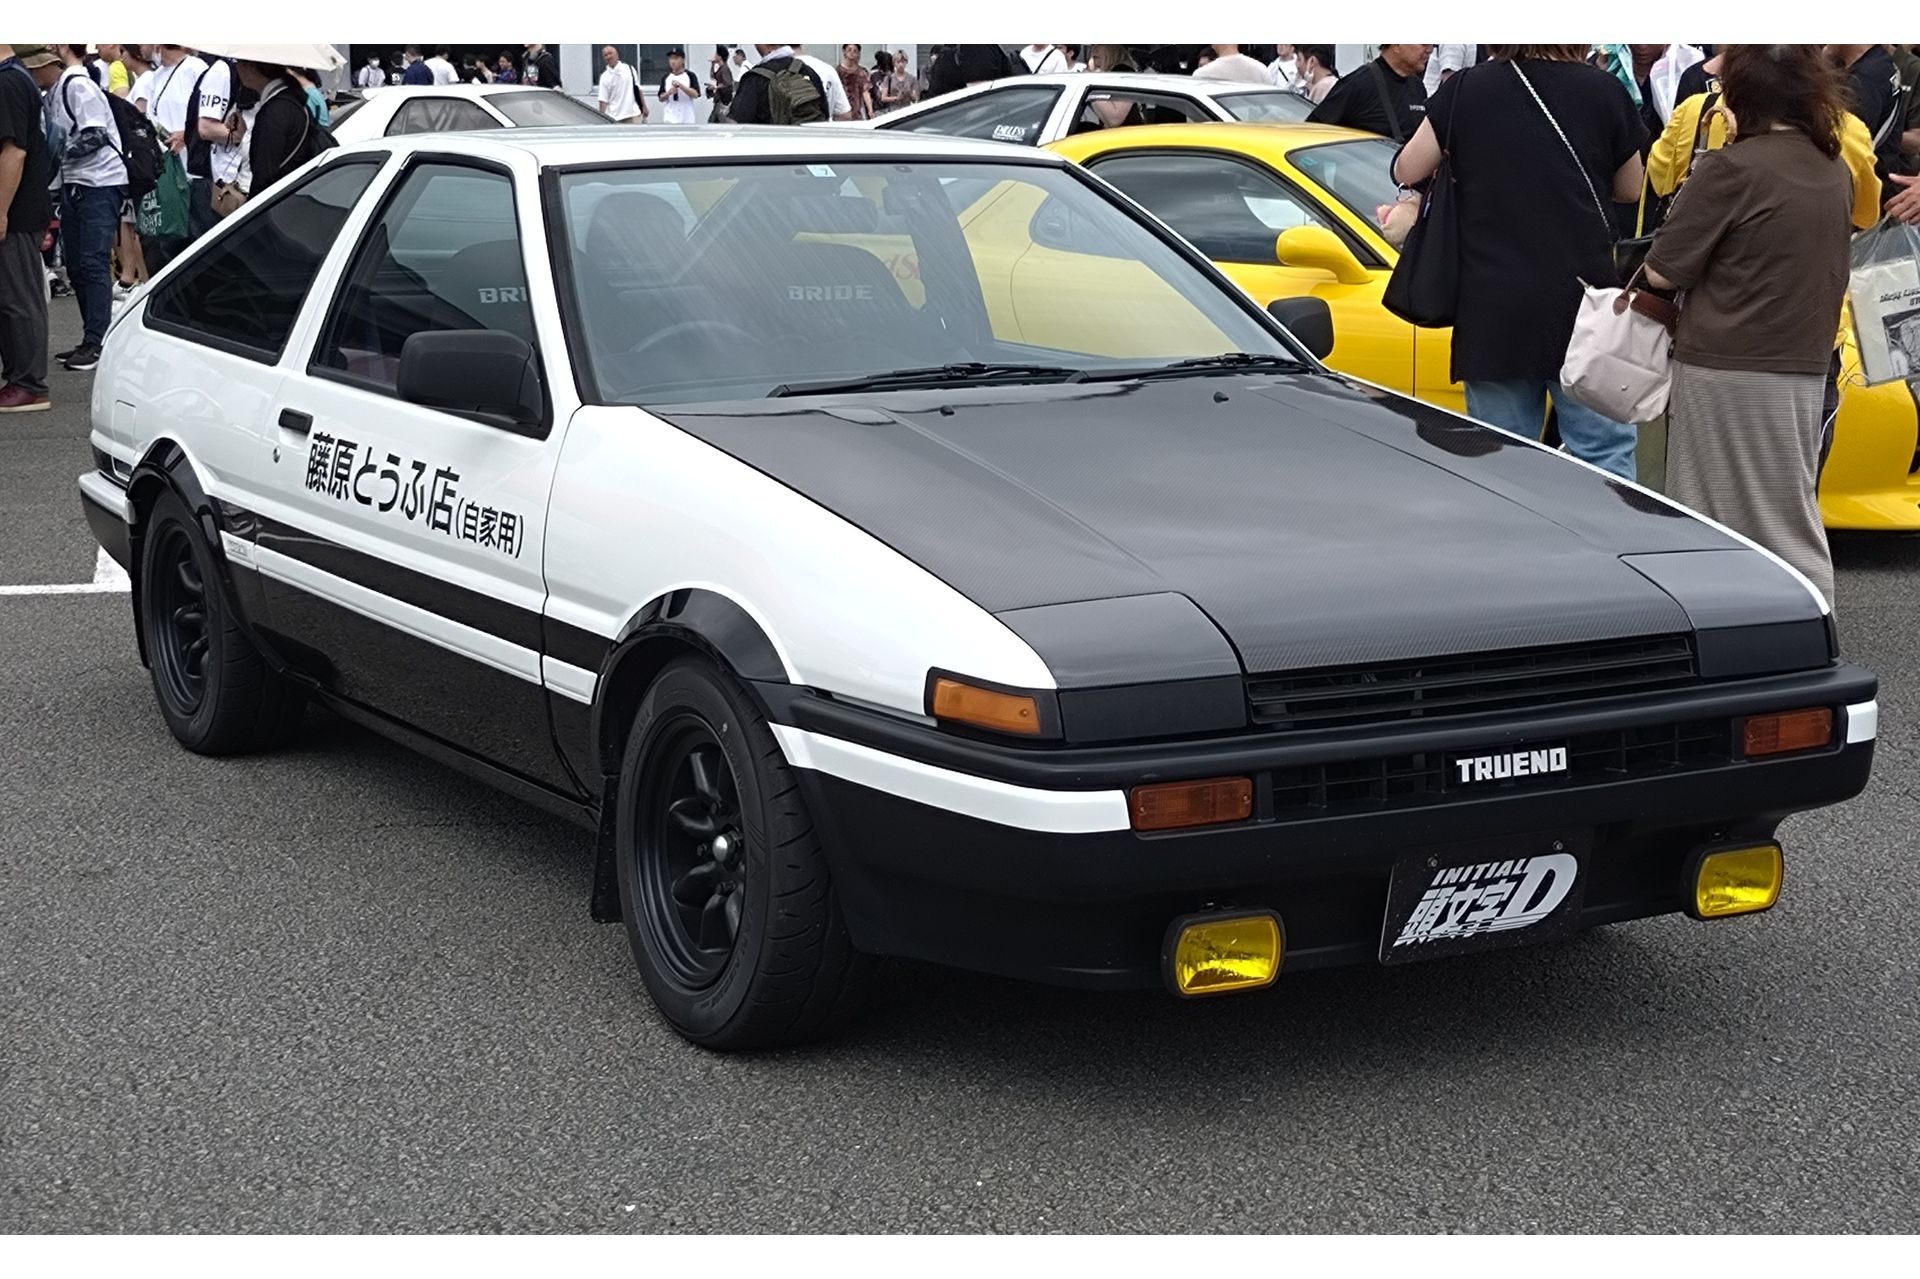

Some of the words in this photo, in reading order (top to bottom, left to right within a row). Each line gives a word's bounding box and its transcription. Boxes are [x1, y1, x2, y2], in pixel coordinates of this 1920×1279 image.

[787, 285, 874, 301] BRIDE
[1456, 747, 1567, 782] TRUENO
[1431, 858, 1529, 887] INITIAL
